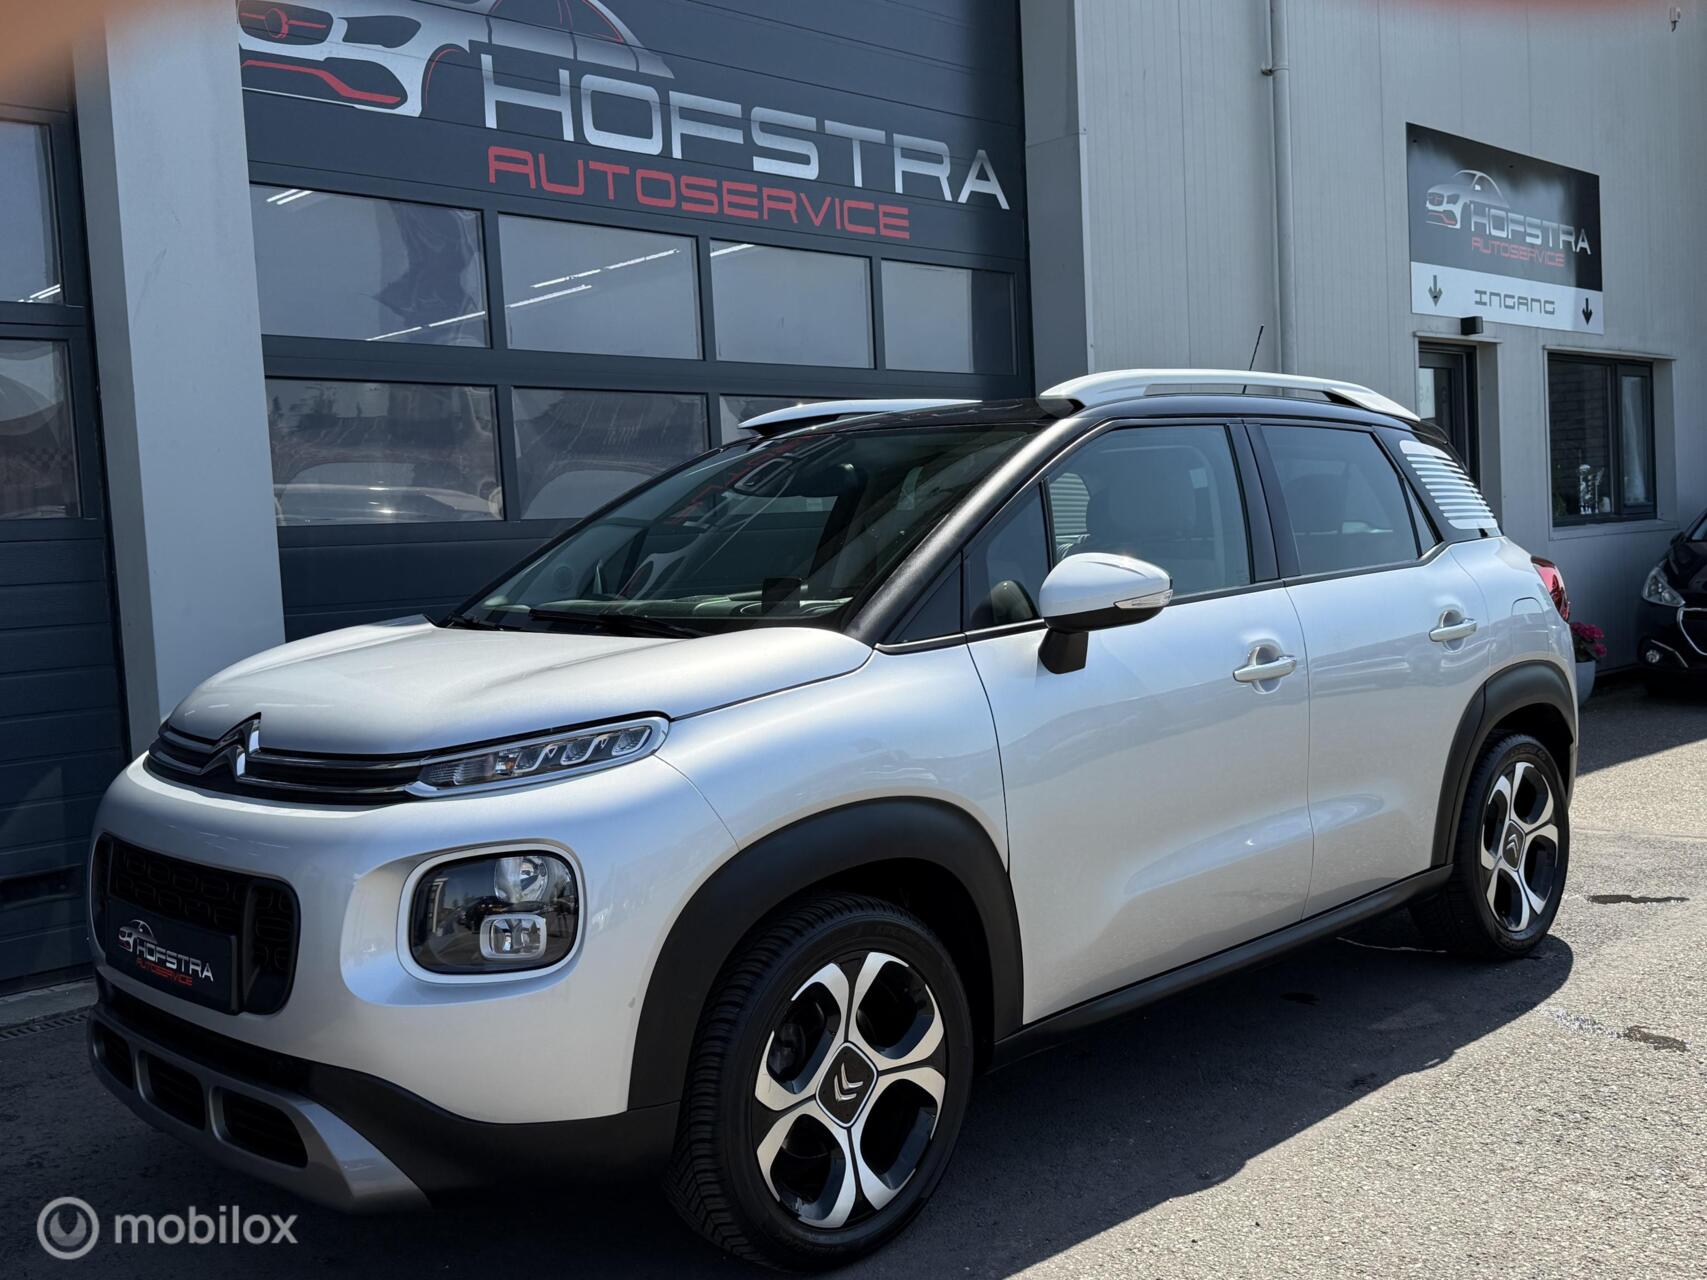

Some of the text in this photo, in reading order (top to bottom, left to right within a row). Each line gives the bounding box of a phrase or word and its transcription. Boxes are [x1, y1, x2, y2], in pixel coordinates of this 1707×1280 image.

[480, 53, 1010, 210] HOFSTRA
[487, 146, 910, 240] AUTOSERVICE
[1470, 203, 1591, 255] HOFSTRA
[1471, 236, 1566, 267] AUTOSERVICE
[1474, 289, 1555, 315] INGANG
[136, 938, 214, 982] HOFSTRA
